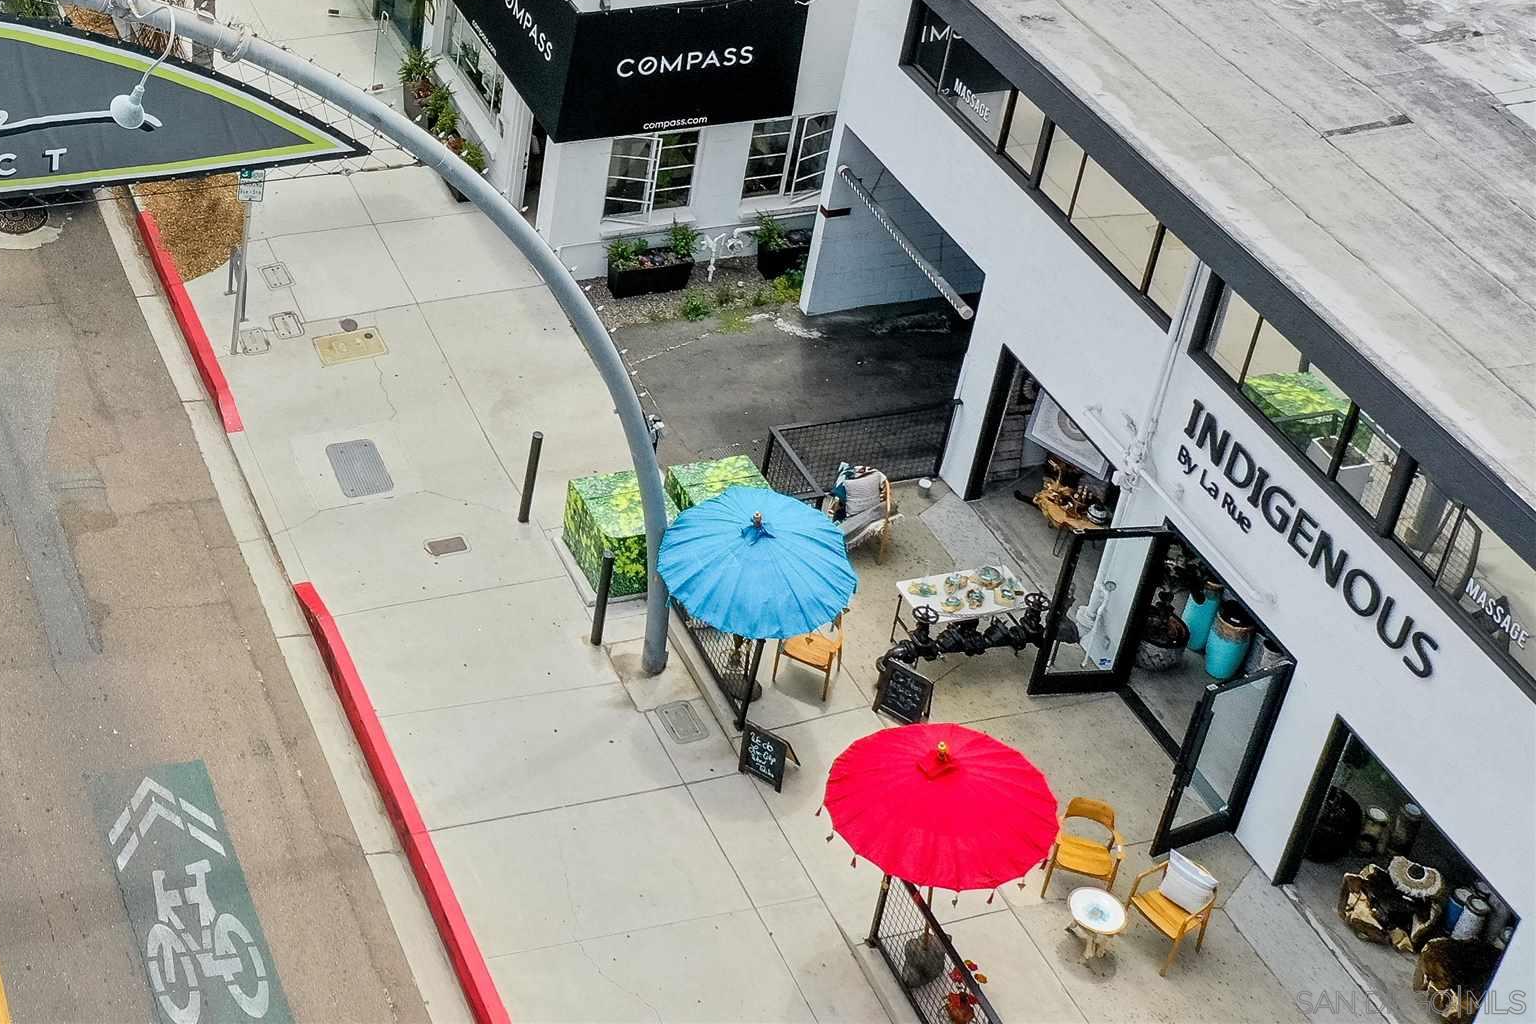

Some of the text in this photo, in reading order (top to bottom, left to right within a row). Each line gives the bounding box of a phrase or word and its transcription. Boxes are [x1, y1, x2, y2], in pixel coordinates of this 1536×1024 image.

[616, 45, 754, 77] COMPASS
[642, 116, 708, 131] compass.com
[953, 77, 991, 122] MASSAGE
[1176, 444, 1253, 534] By La Rue
[1183, 398, 1439, 679] INDIGENOUS
[1465, 577, 1529, 648] MASSAGE
